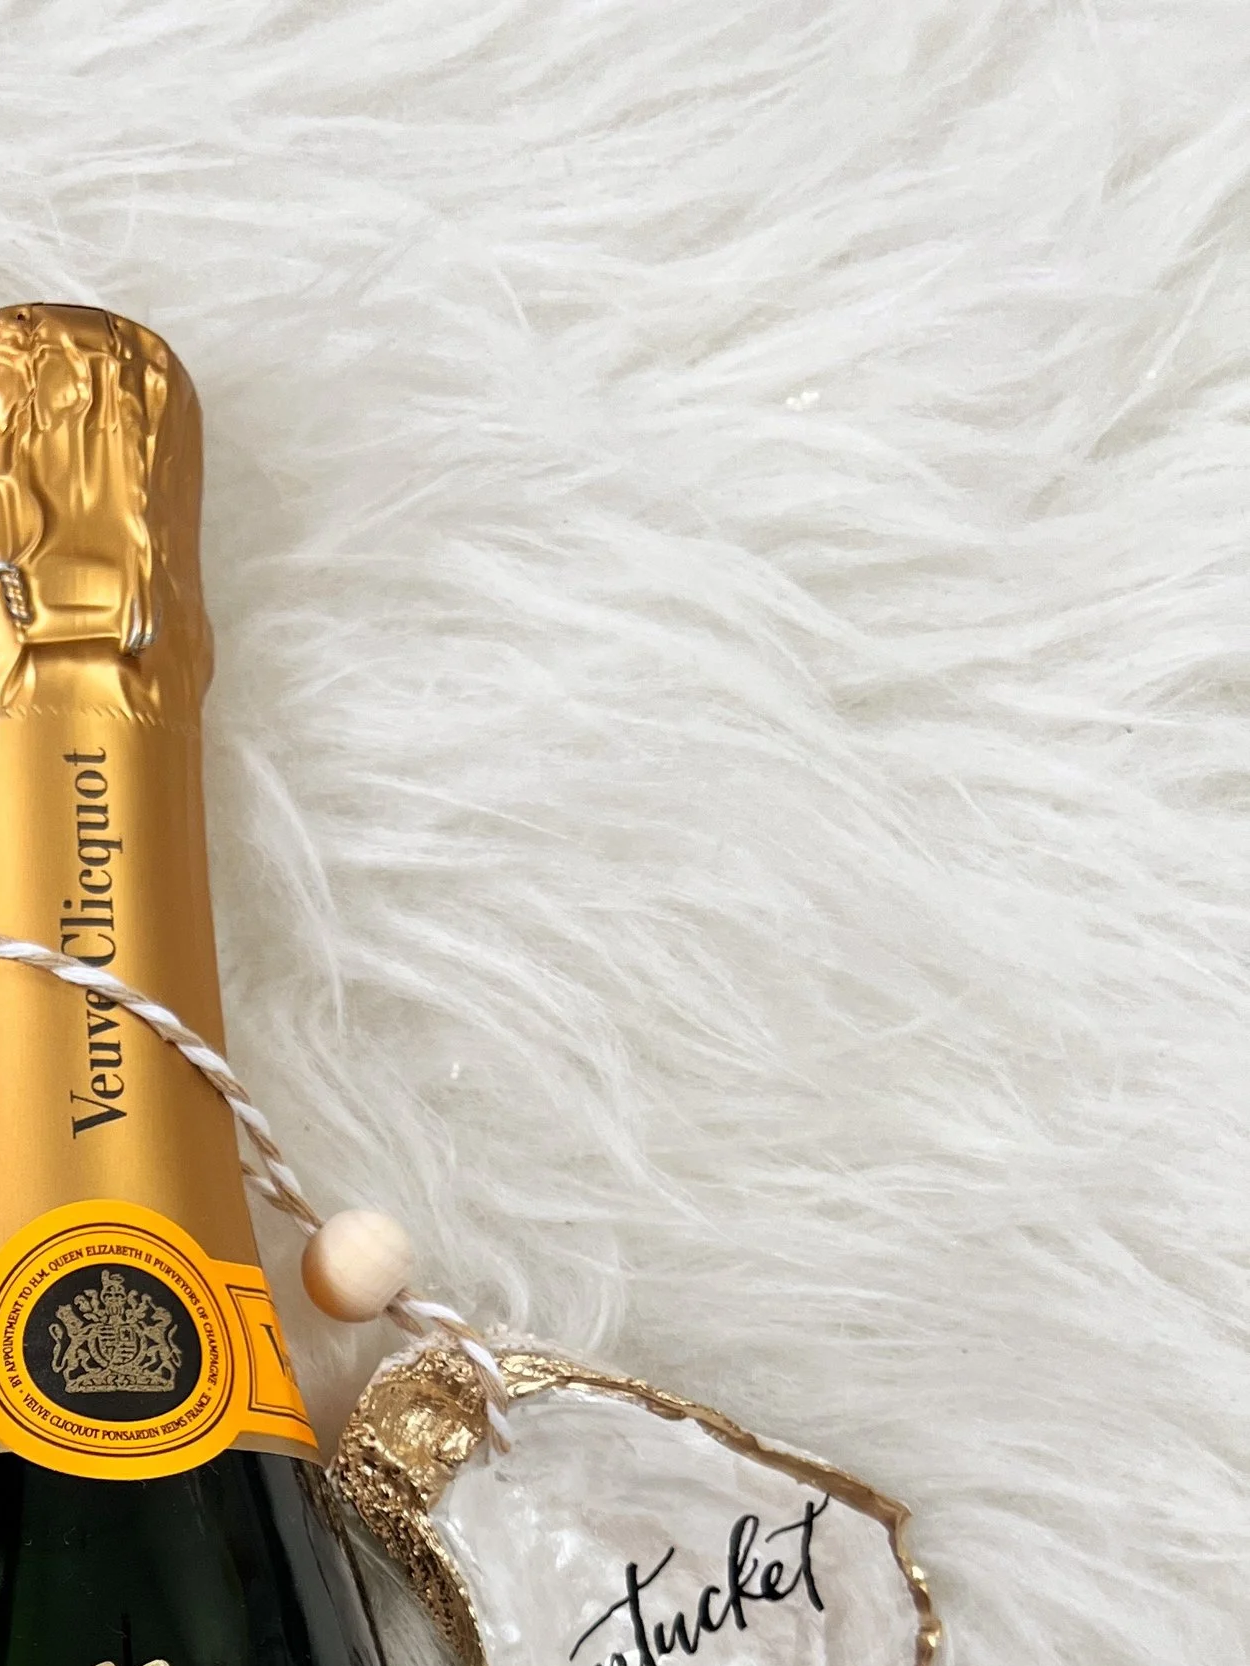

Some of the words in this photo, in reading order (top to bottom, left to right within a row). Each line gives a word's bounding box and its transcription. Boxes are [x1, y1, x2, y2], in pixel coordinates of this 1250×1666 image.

[60, 746, 124, 968] Clicquot
[70, 986, 128, 1139] Veuve
[48, 1249, 84, 1272] QUEEN
[86, 1244, 144, 1261] ELIZABETH
[144, 1252, 153, 1264] II
[18, 1286, 33, 1302] TO
[152, 1257, 200, 1306] PURVEYORS
[196, 1305, 209, 1321] OF
[2, 1301, 23, 1375] APPOINTMENT
[202, 1320, 220, 1386] CHAMPAGNE
[7, 1375, 23, 1389] BY
[22, 1392, 51, 1421] VEUVE
[49, 1414, 100, 1440] CLICQUOT
[101, 1426, 160, 1441] PONSARDIN
[160, 1418, 188, 1436] REIMS
[186, 1391, 212, 1423] FRANCE
